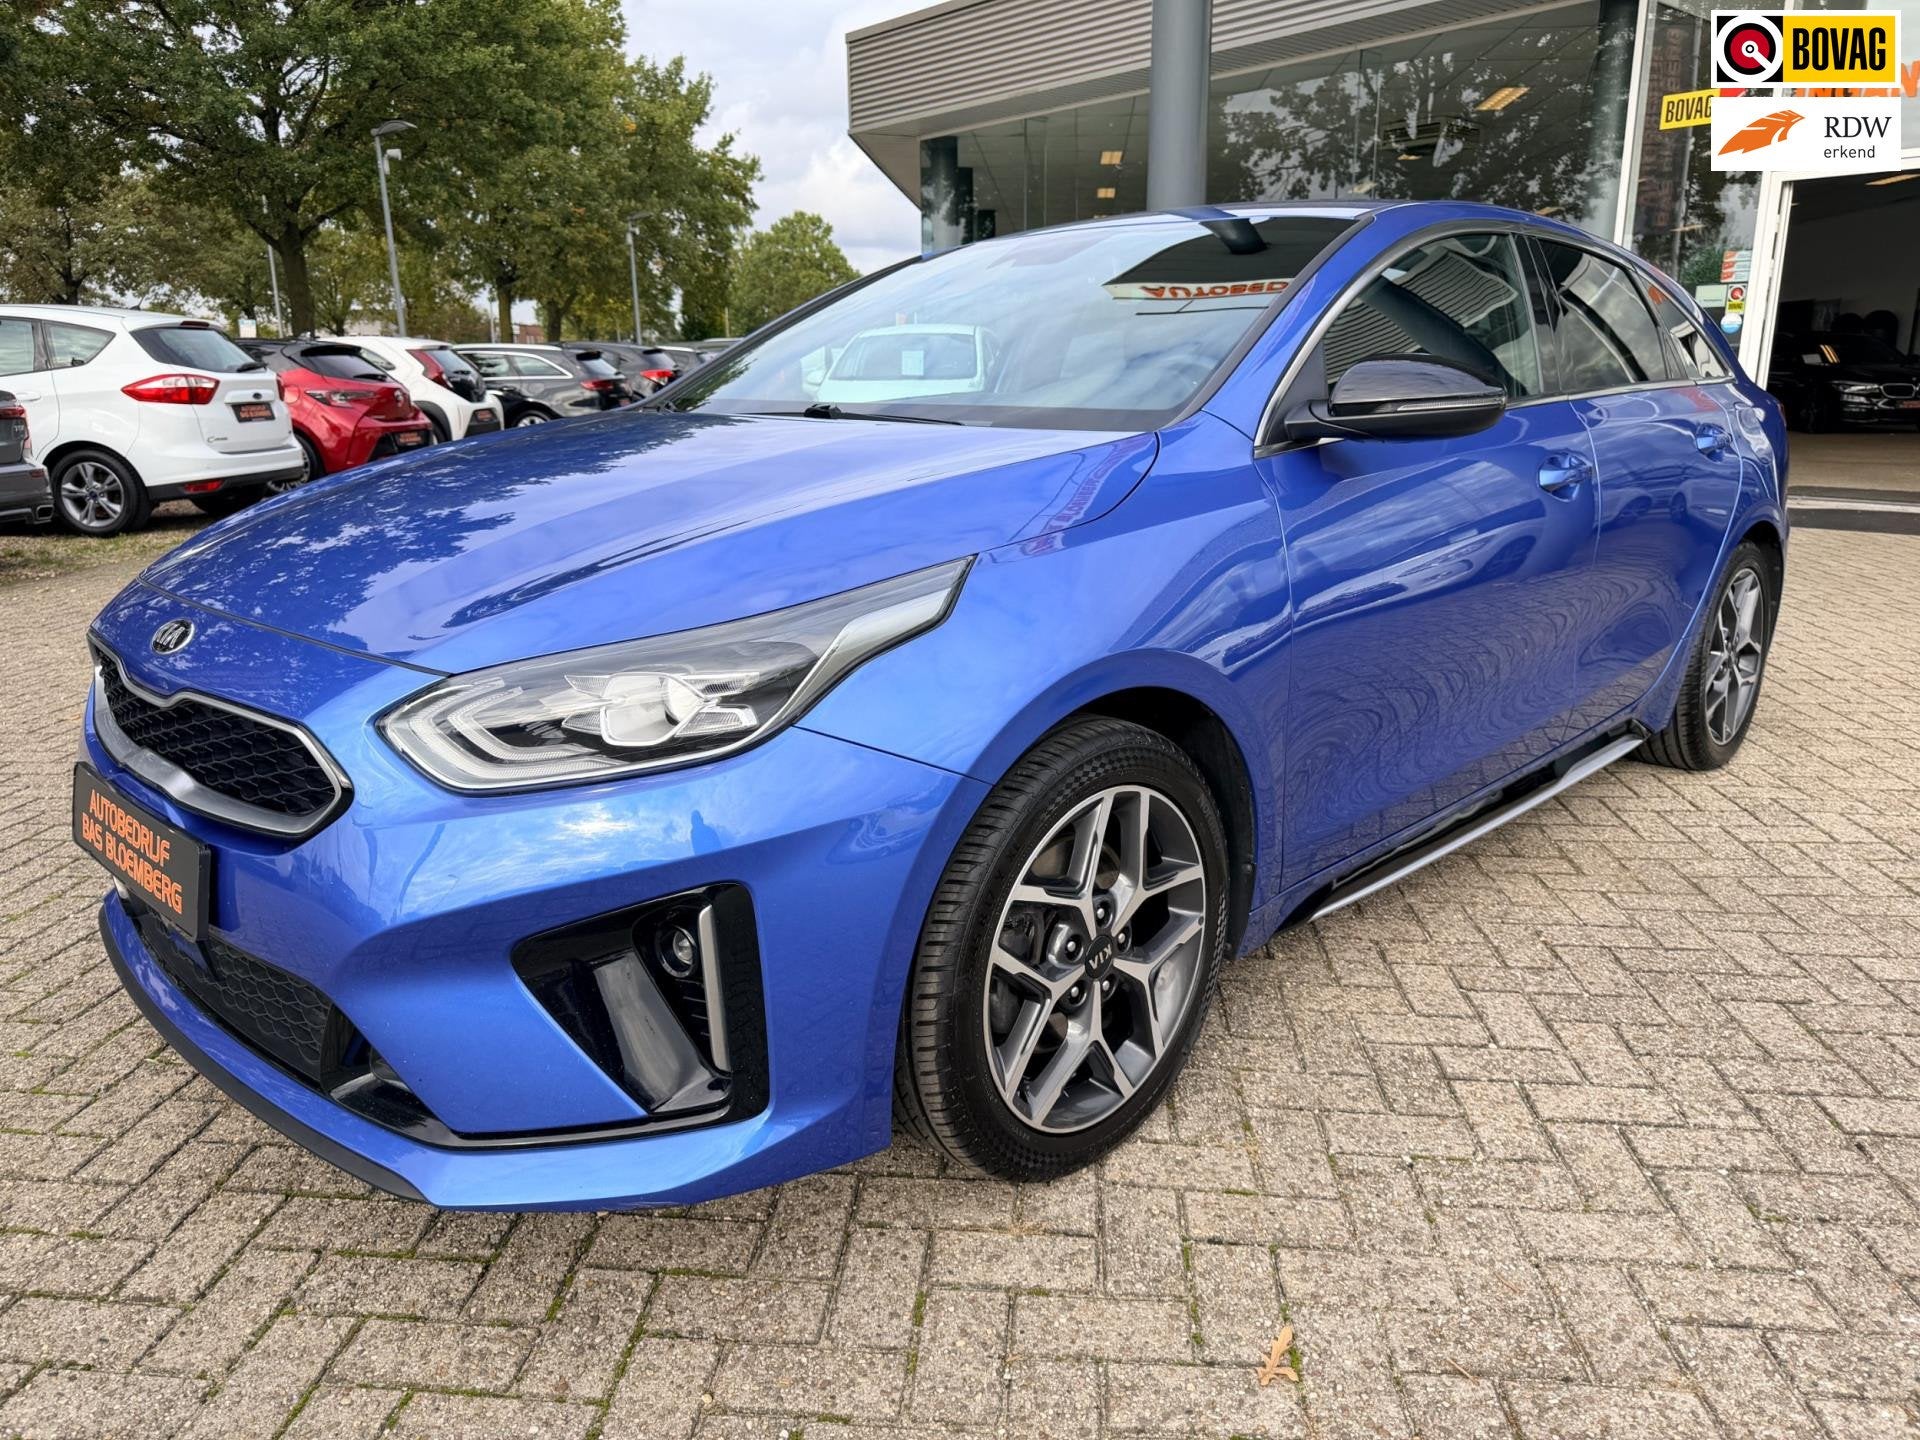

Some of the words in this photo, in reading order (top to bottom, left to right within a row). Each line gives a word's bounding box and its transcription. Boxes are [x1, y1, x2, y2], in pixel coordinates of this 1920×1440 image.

[82, 812, 103, 851] BAS
[105, 831, 182, 914] BLOEMBERG
[89, 789, 170, 866] AUTOBEDRIJF
[1089, 943, 1112, 969] KIA
